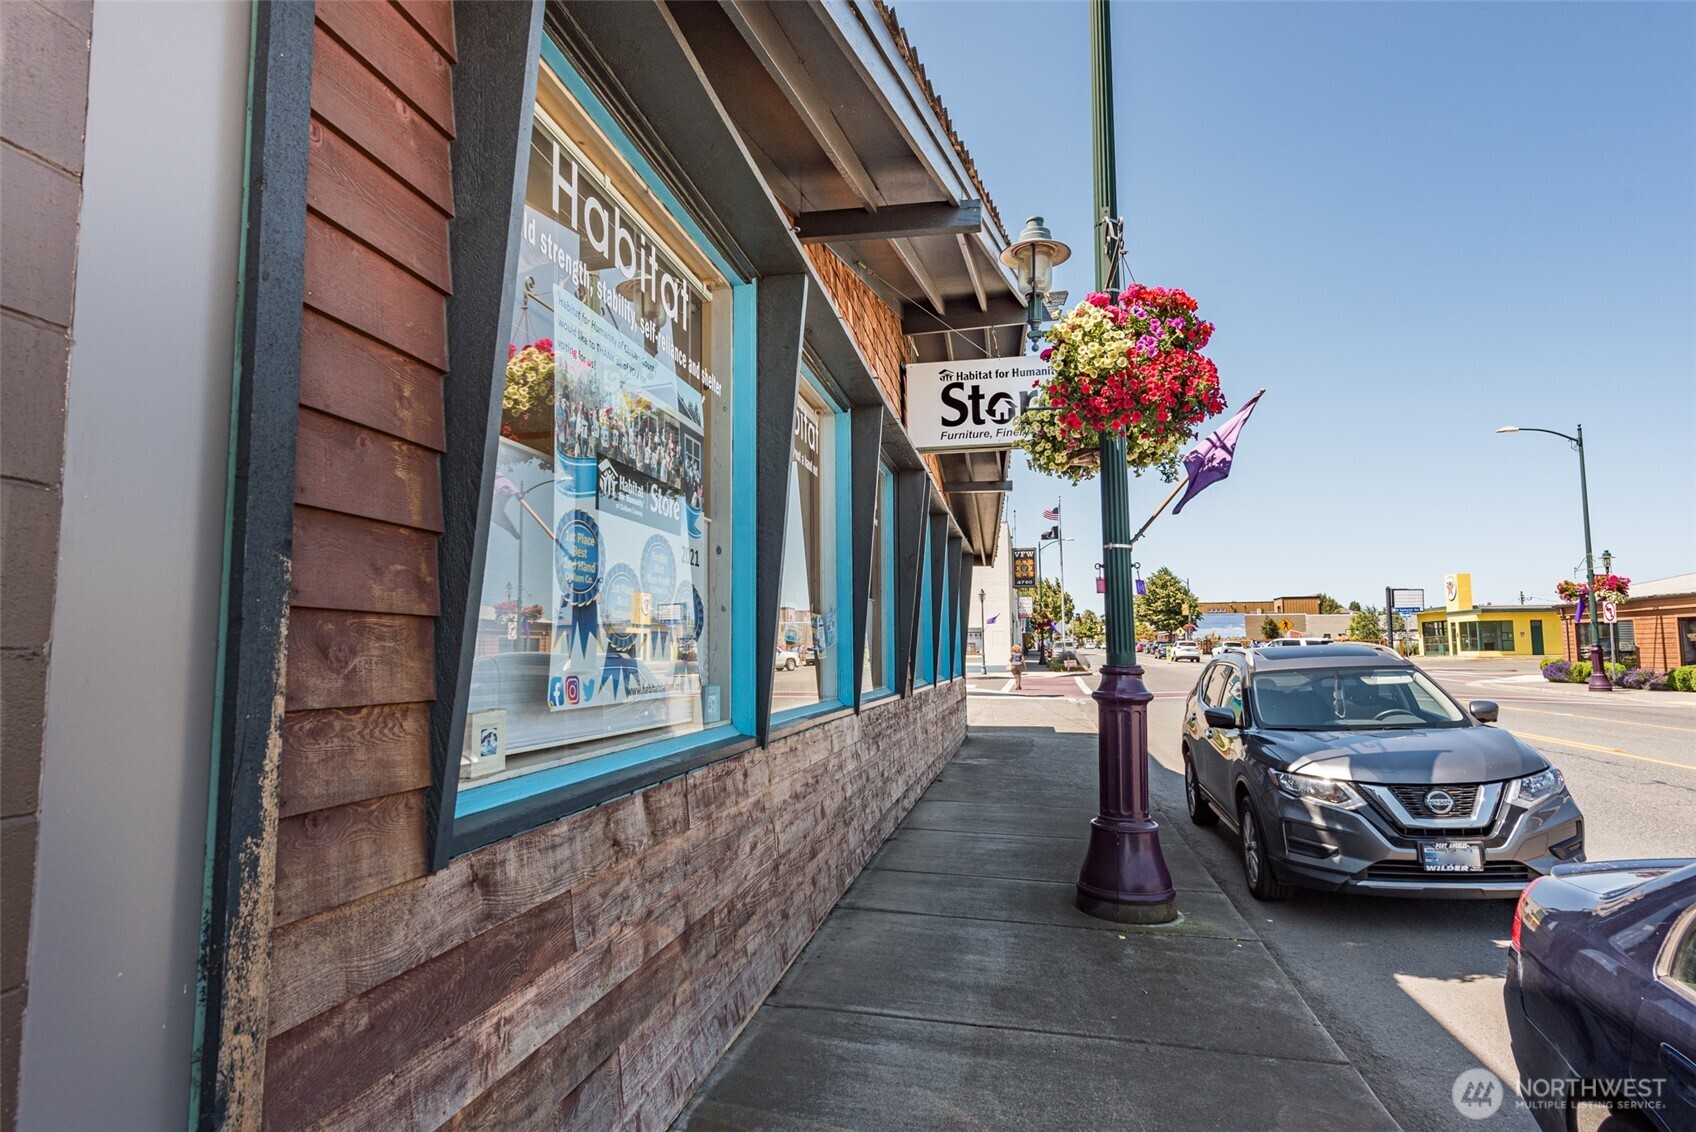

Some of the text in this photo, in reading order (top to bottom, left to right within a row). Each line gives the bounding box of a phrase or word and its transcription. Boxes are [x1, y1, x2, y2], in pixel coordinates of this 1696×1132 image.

[551, 140, 689, 332] Habitat
[540, 233, 594, 298] strength,
[596, 280, 638, 333] stability,
[640, 316, 687, 369] self-reliance
[688, 358, 701, 381] and
[702, 368, 722, 397] shelter
[559, 299, 581, 321] Habitat
[581, 312, 591, 326] for
[591, 320, 619, 348] Humanity
[956, 370, 993, 381] Habitat
[995, 369, 1010, 379] for
[941, 382, 1039, 428] Stor
[940, 430, 993, 440] Furniture,
[619, 475, 680, 520] Habitat Store
[573, 545, 588, 558] Best
[577, 532, 595, 547] Place
[577, 560, 596, 573] Hand
